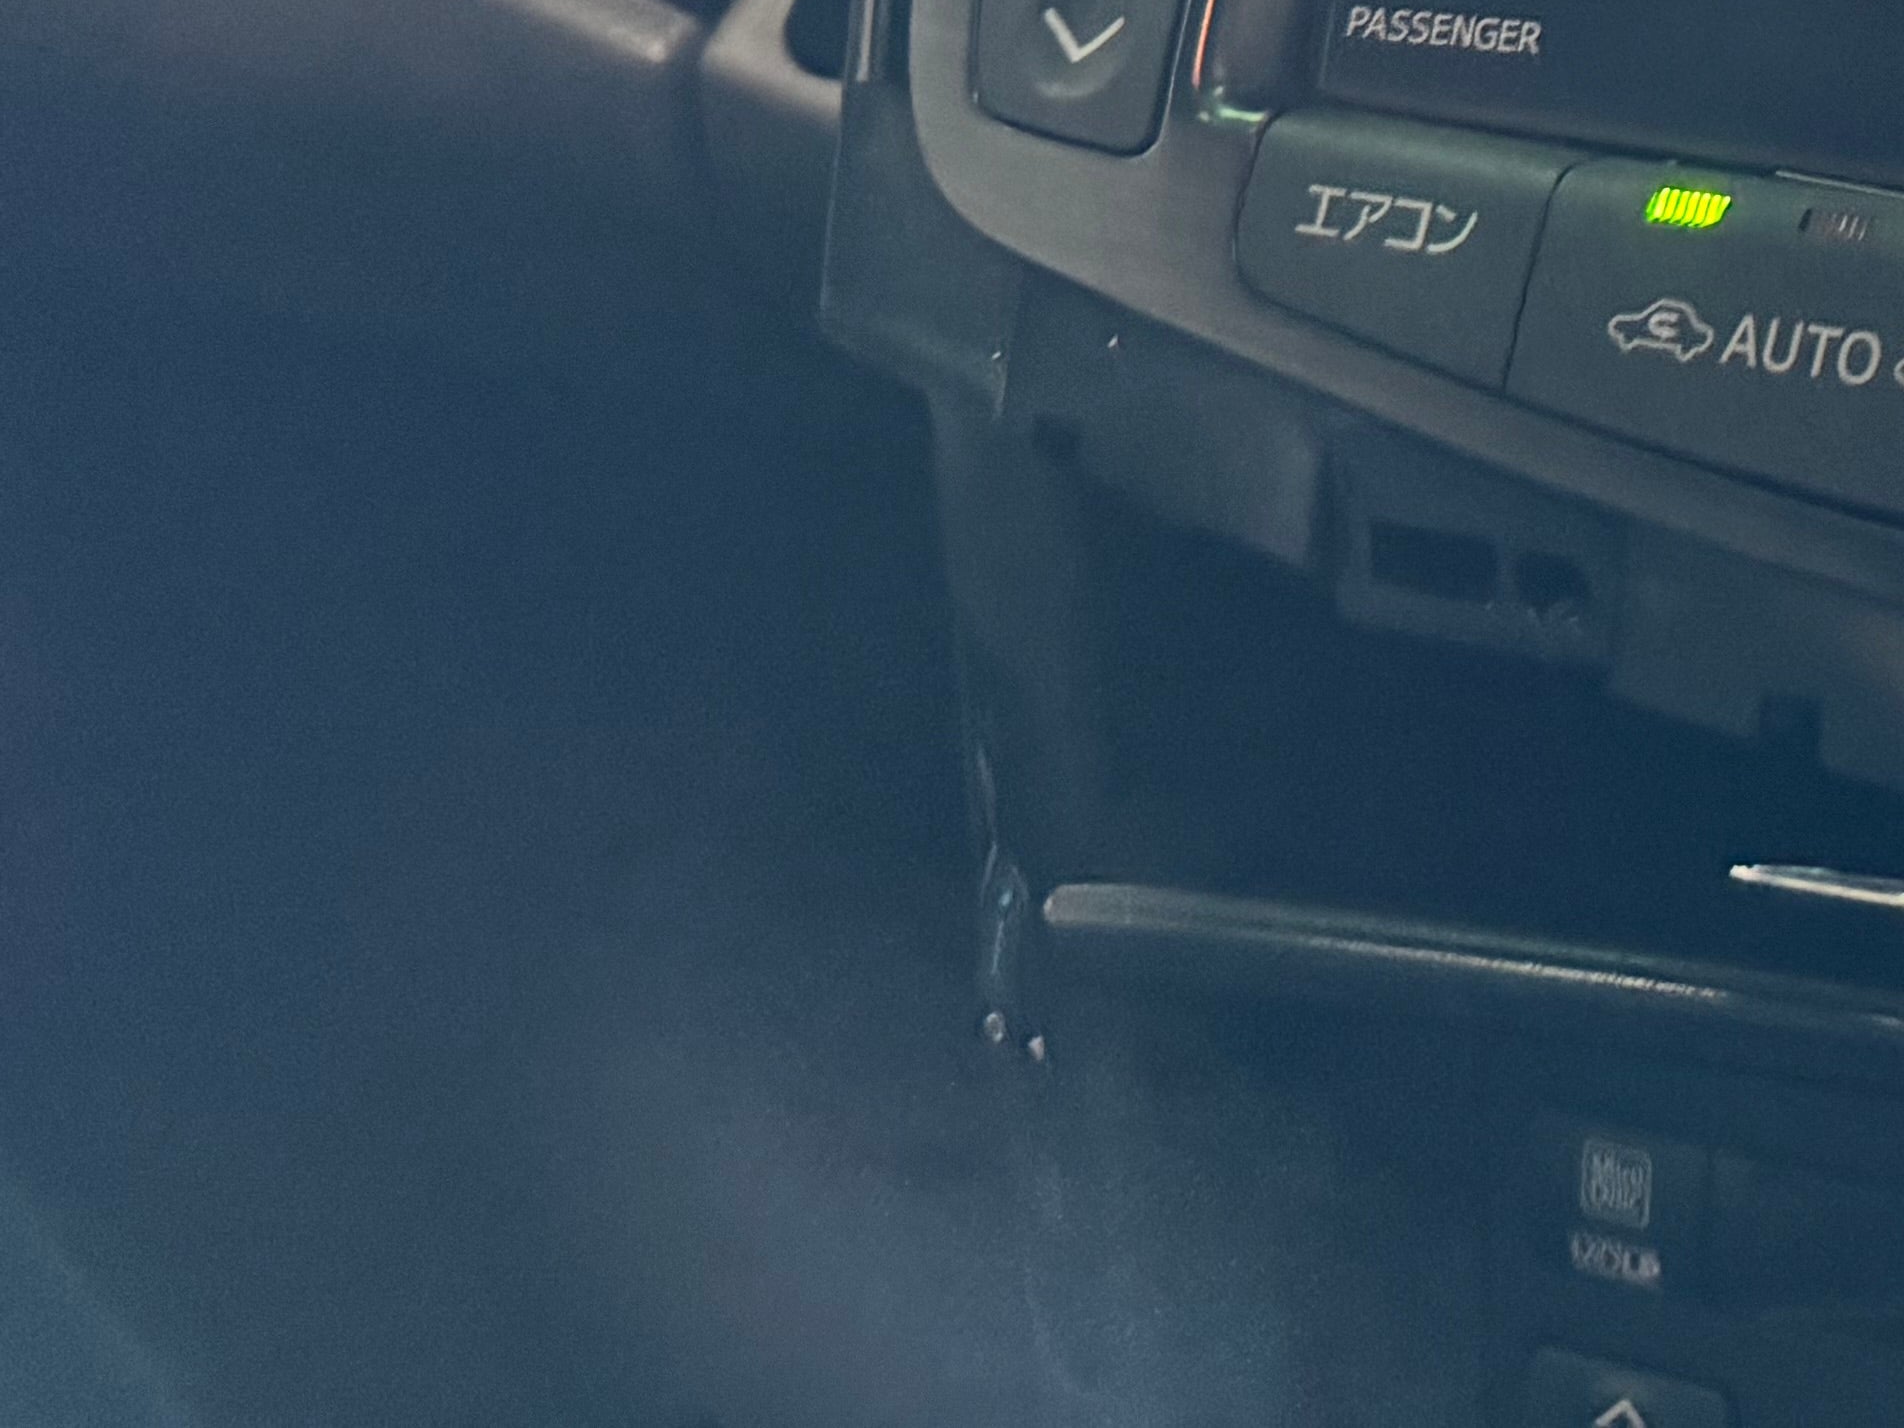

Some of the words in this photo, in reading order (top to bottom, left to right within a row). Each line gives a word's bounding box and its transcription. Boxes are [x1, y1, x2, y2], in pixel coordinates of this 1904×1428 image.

[1346, 4, 1543, 56] PASSENGER
[1294, 183, 1478, 256] エアコン
[1719, 313, 1883, 386] AUTO
